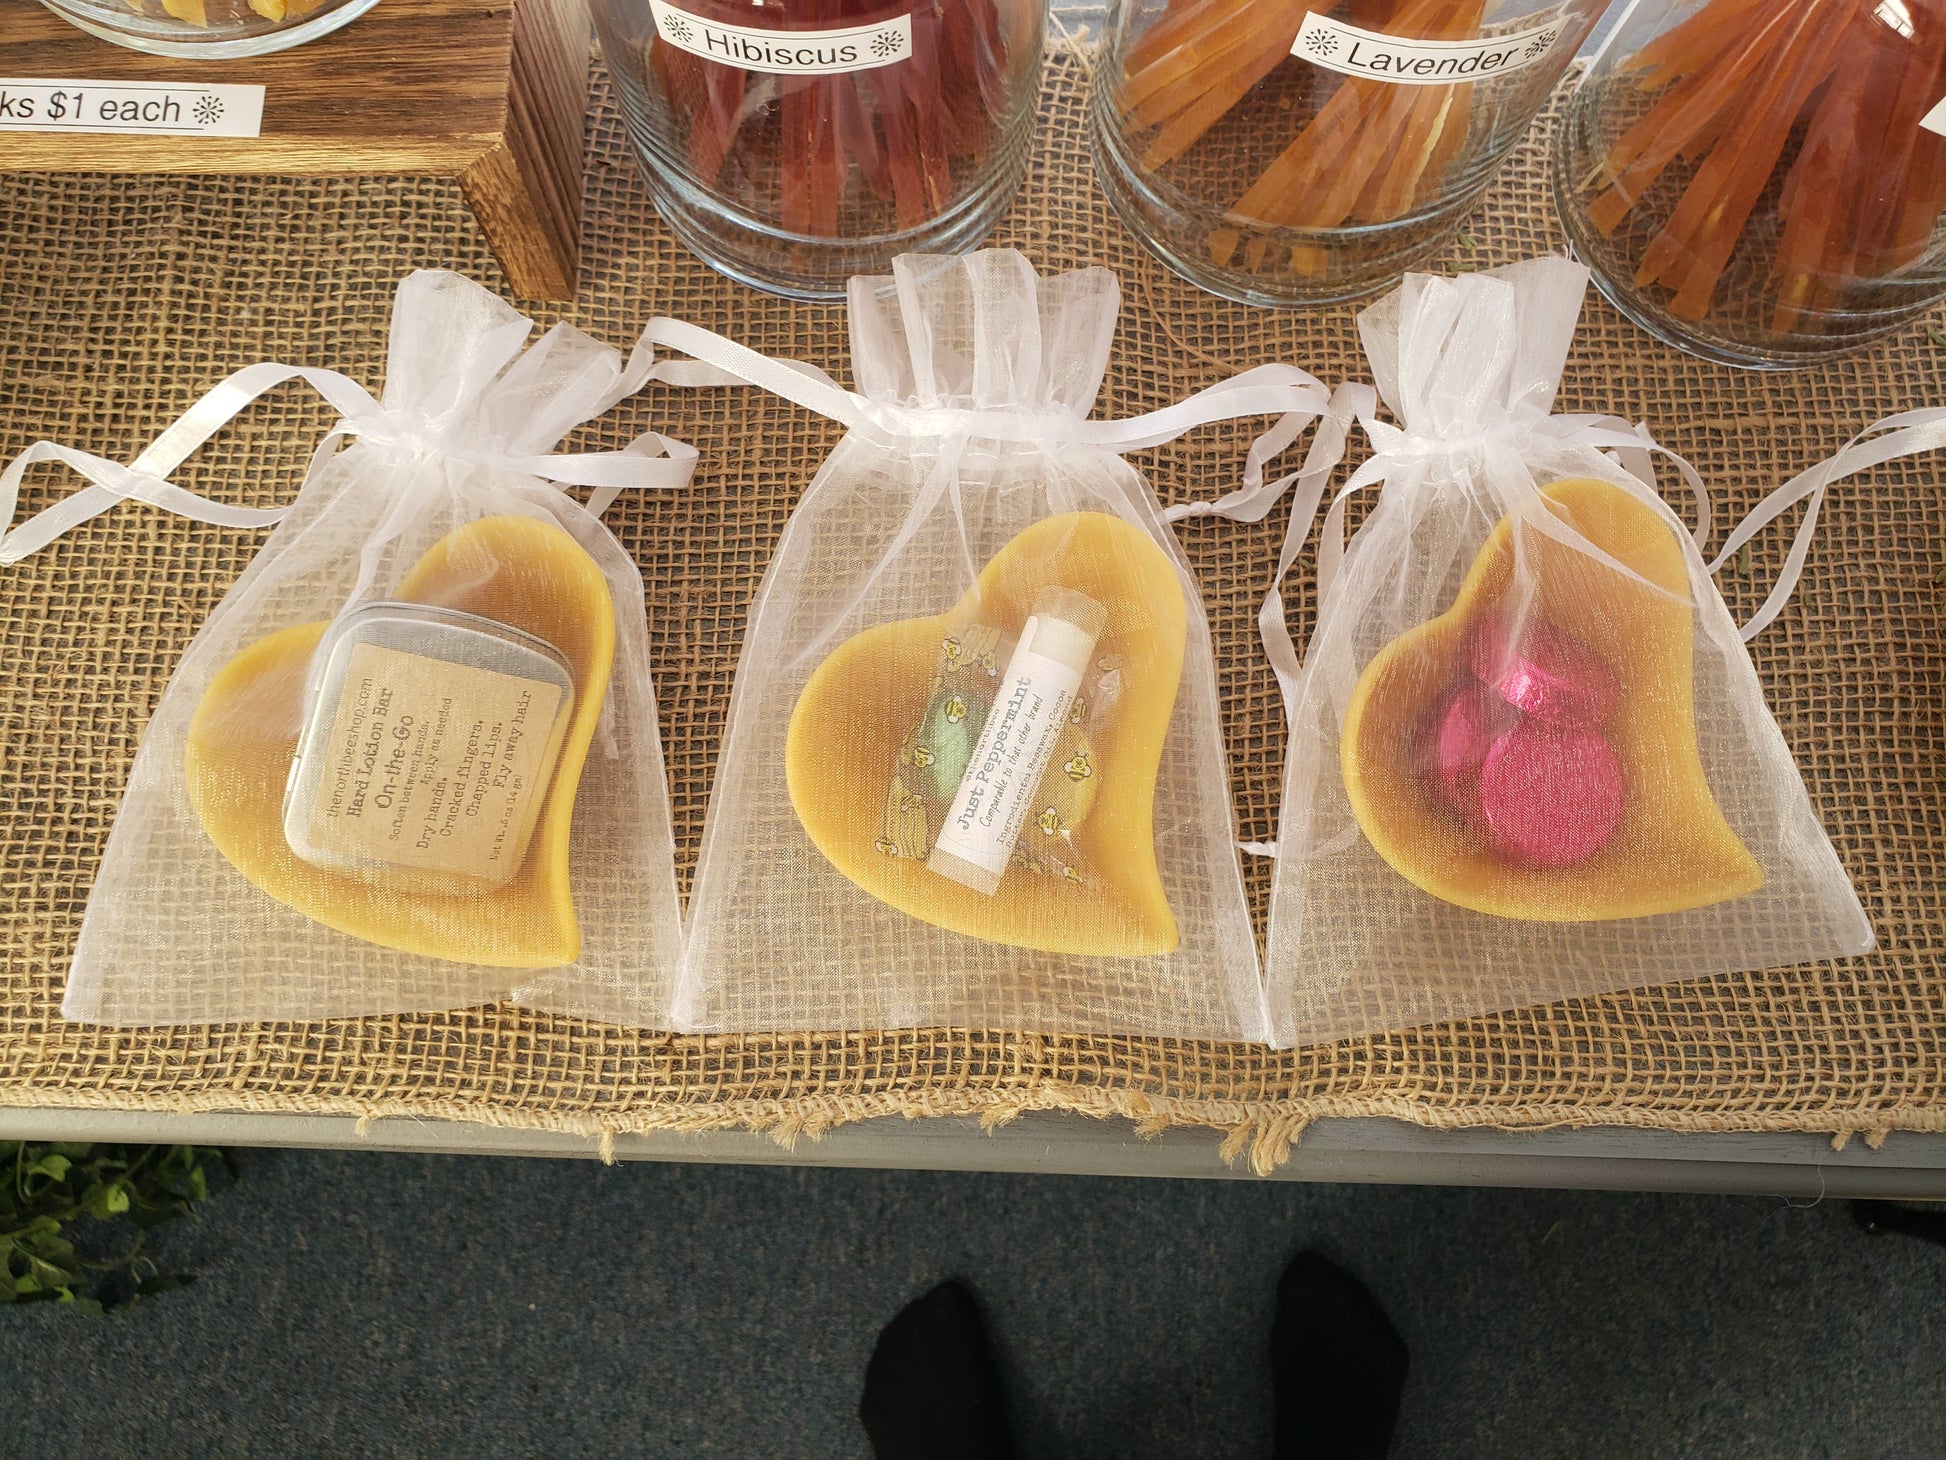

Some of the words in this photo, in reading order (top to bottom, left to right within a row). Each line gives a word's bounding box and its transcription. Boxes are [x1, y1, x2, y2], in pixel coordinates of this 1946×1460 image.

[705, 29, 858, 66] Hibiscus
[1347, 42, 1519, 75] Lavender
[47, 91, 84, 121] $1
[99, 95, 181, 122] each
[372, 687, 393, 717] Bar
[433, 697, 452, 736] needed
[511, 689, 532, 725] hair
[1024, 693, 1044, 720] brand
[325, 677, 375, 817] thenorthbeeshop.com
[356, 719, 384, 777] Lotion
[430, 737, 441, 752] as
[502, 726, 524, 761] away
[1013, 721, 1032, 744] other
[372, 712, 414, 810] On-the-Go
[419, 753, 439, 785] Apply
[954, 784, 985, 831] Just
[974, 673, 1032, 785] Peppermint
[1004, 743, 1022, 765] that
[464, 759, 495, 817] Chapped
[492, 763, 513, 788] Fly
[1002, 766, 1013, 776] to
[345, 779, 369, 818] Hard
[388, 805, 406, 841] Soften
[399, 758, 420, 804] between
[439, 781, 466, 838] Cracked
[977, 776, 1009, 829] Comparable
[415, 824, 436, 850] Dry
